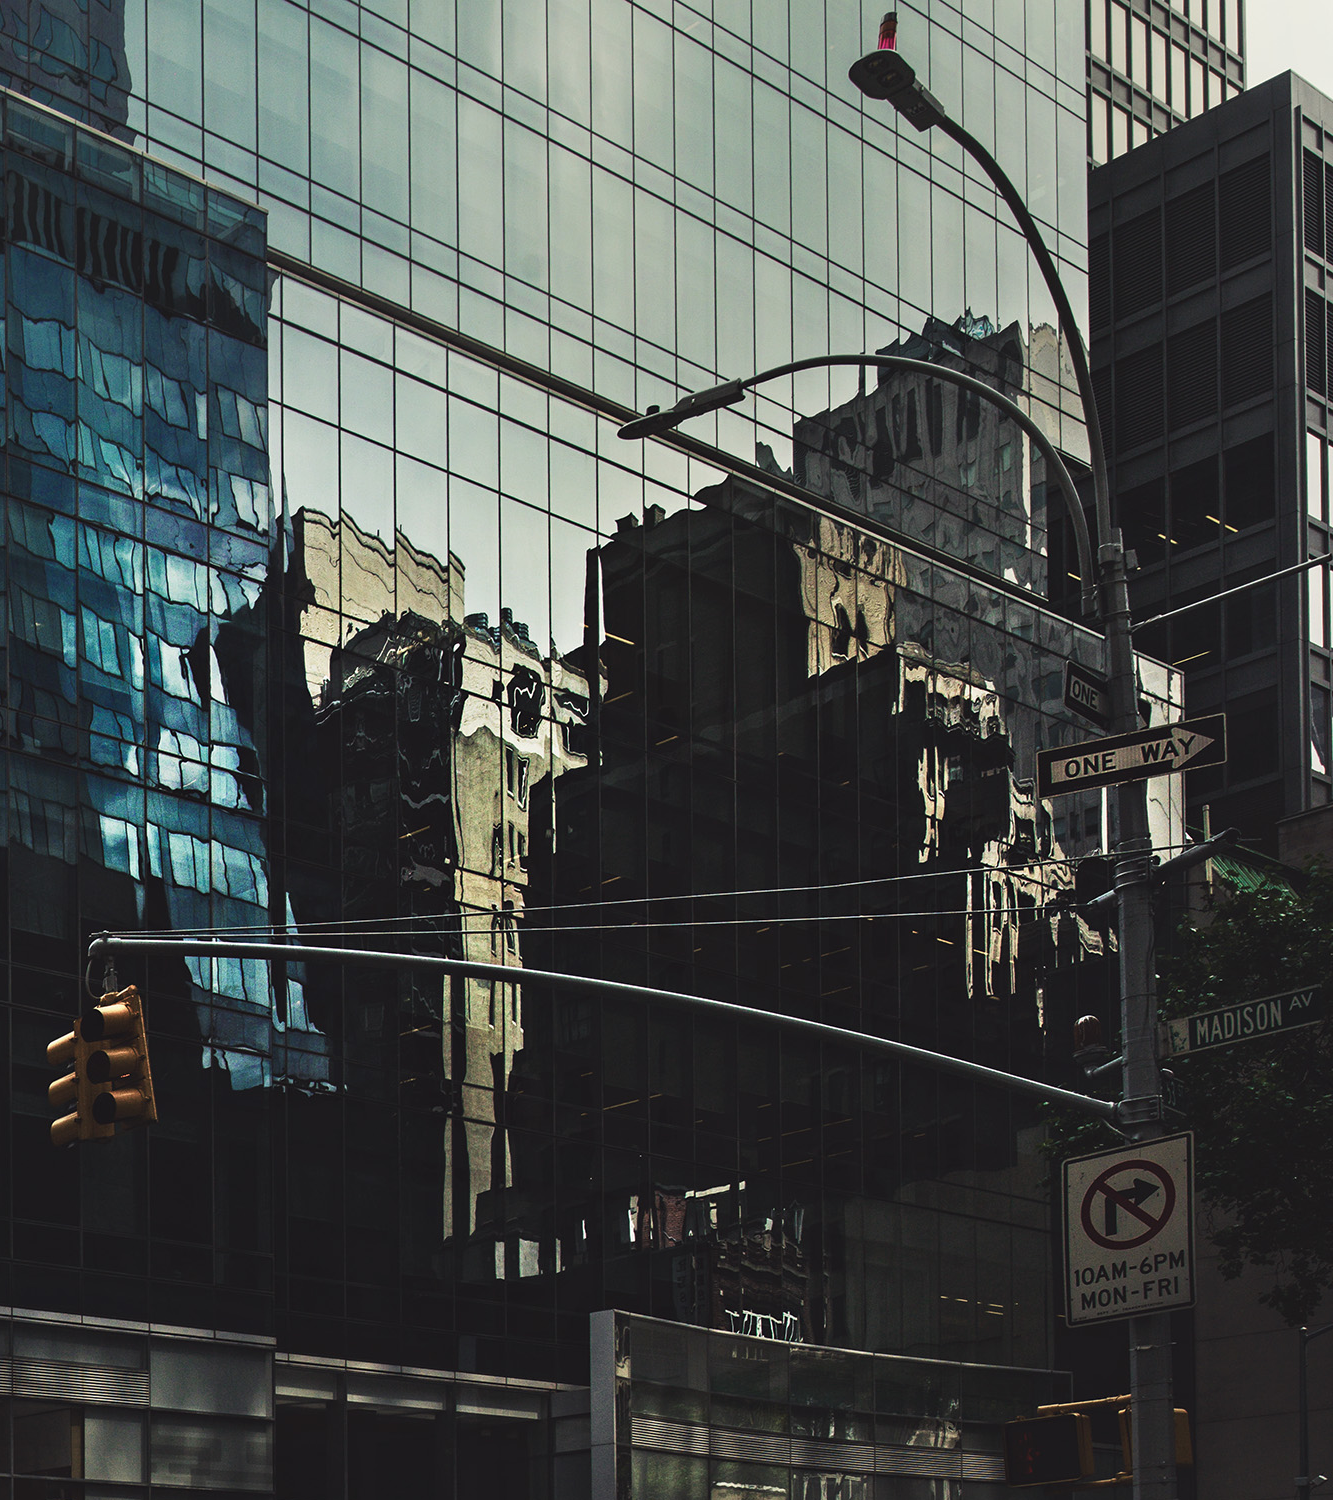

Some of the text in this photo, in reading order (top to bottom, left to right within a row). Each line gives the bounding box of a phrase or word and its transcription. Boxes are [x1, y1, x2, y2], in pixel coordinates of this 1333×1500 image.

[1072, 680, 1098, 711] ONE
[1064, 734, 1197, 779] ONE WAY
[1196, 991, 1313, 1046] MADISON AV
[1074, 1249, 1185, 1287] 10AM-6PM
[1081, 1276, 1179, 1311] MON-FRI
